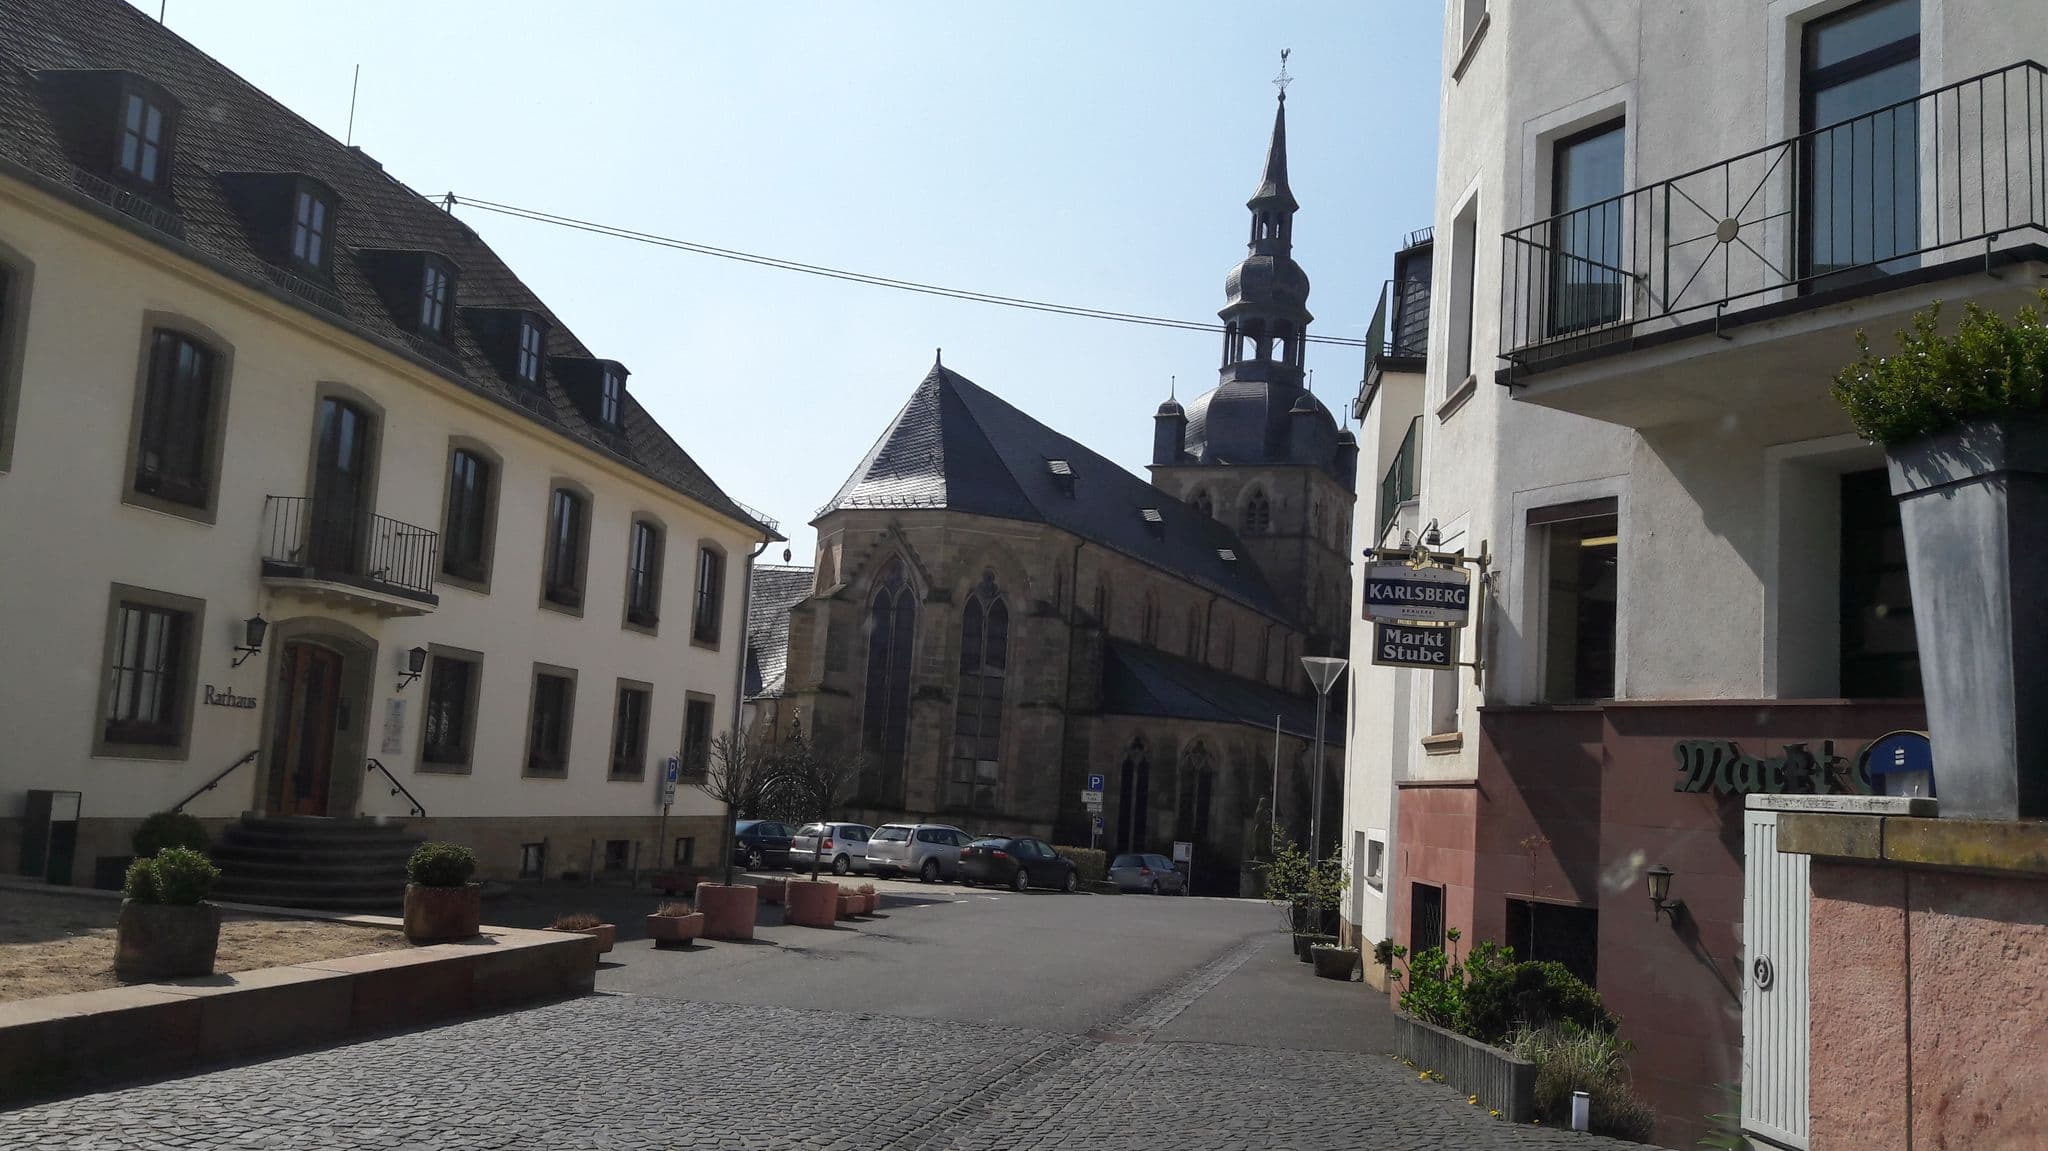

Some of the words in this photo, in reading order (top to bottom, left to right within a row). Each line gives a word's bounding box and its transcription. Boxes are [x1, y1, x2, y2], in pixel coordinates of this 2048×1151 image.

[1369, 583, 1466, 604] KARLSBERG
[1385, 628, 1445, 647] Markt
[1383, 645, 1445, 663] Stube
[203, 684, 257, 709] Rathaus
[669, 762, 676, 777] P
[1673, 739, 1834, 794] Mart
[1091, 776, 1100, 789] P
